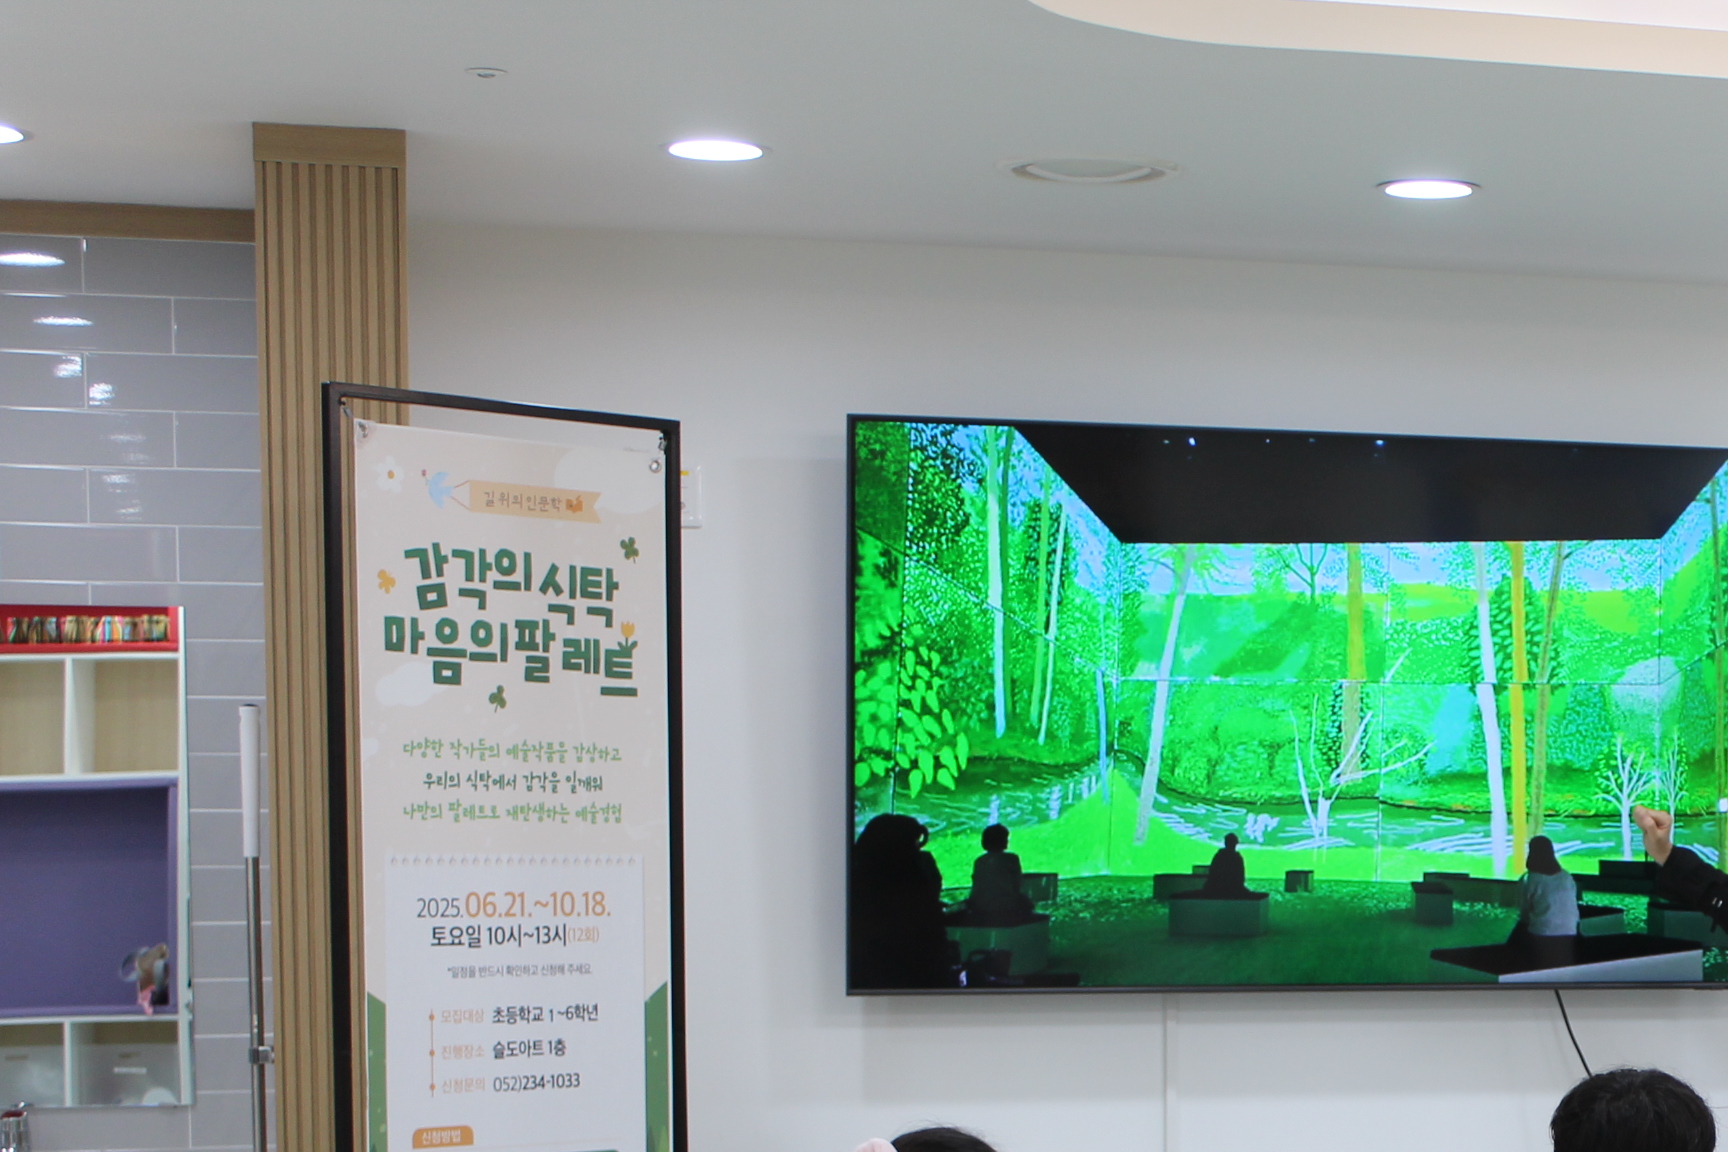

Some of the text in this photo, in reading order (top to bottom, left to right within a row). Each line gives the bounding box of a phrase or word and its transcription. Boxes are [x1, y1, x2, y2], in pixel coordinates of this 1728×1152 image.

[526, 495, 562, 512] 인문학
[404, 542, 619, 628] 감각의 식탁
[384, 615, 638, 697] 마음의 팔레트
[403, 737, 622, 763] 다양한 작가들의 예술작품을 감상하고
[423, 769, 603, 794] 우리의 식탁에서 감각을 일깨워
[403, 799, 622, 825] 나만의 팔레트로 재탄생하는 예술경험
[430, 924, 482, 948] 토요일
[478, 964, 504, 977] 반드시
[506, 963, 538, 977] 확인하고
[541, 963, 565, 976] 신청해
[442, 1009, 484, 1024] 모집대상
[492, 1005, 544, 1025] 초등학교
[442, 1044, 485, 1060] 진행장소
[492, 1038, 566, 1060] 슬도아트 1층
[442, 1077, 485, 1094] 신청문의
[493, 1072, 581, 1092] 052)234-1033
[422, 1128, 461, 1146] 신청방법
